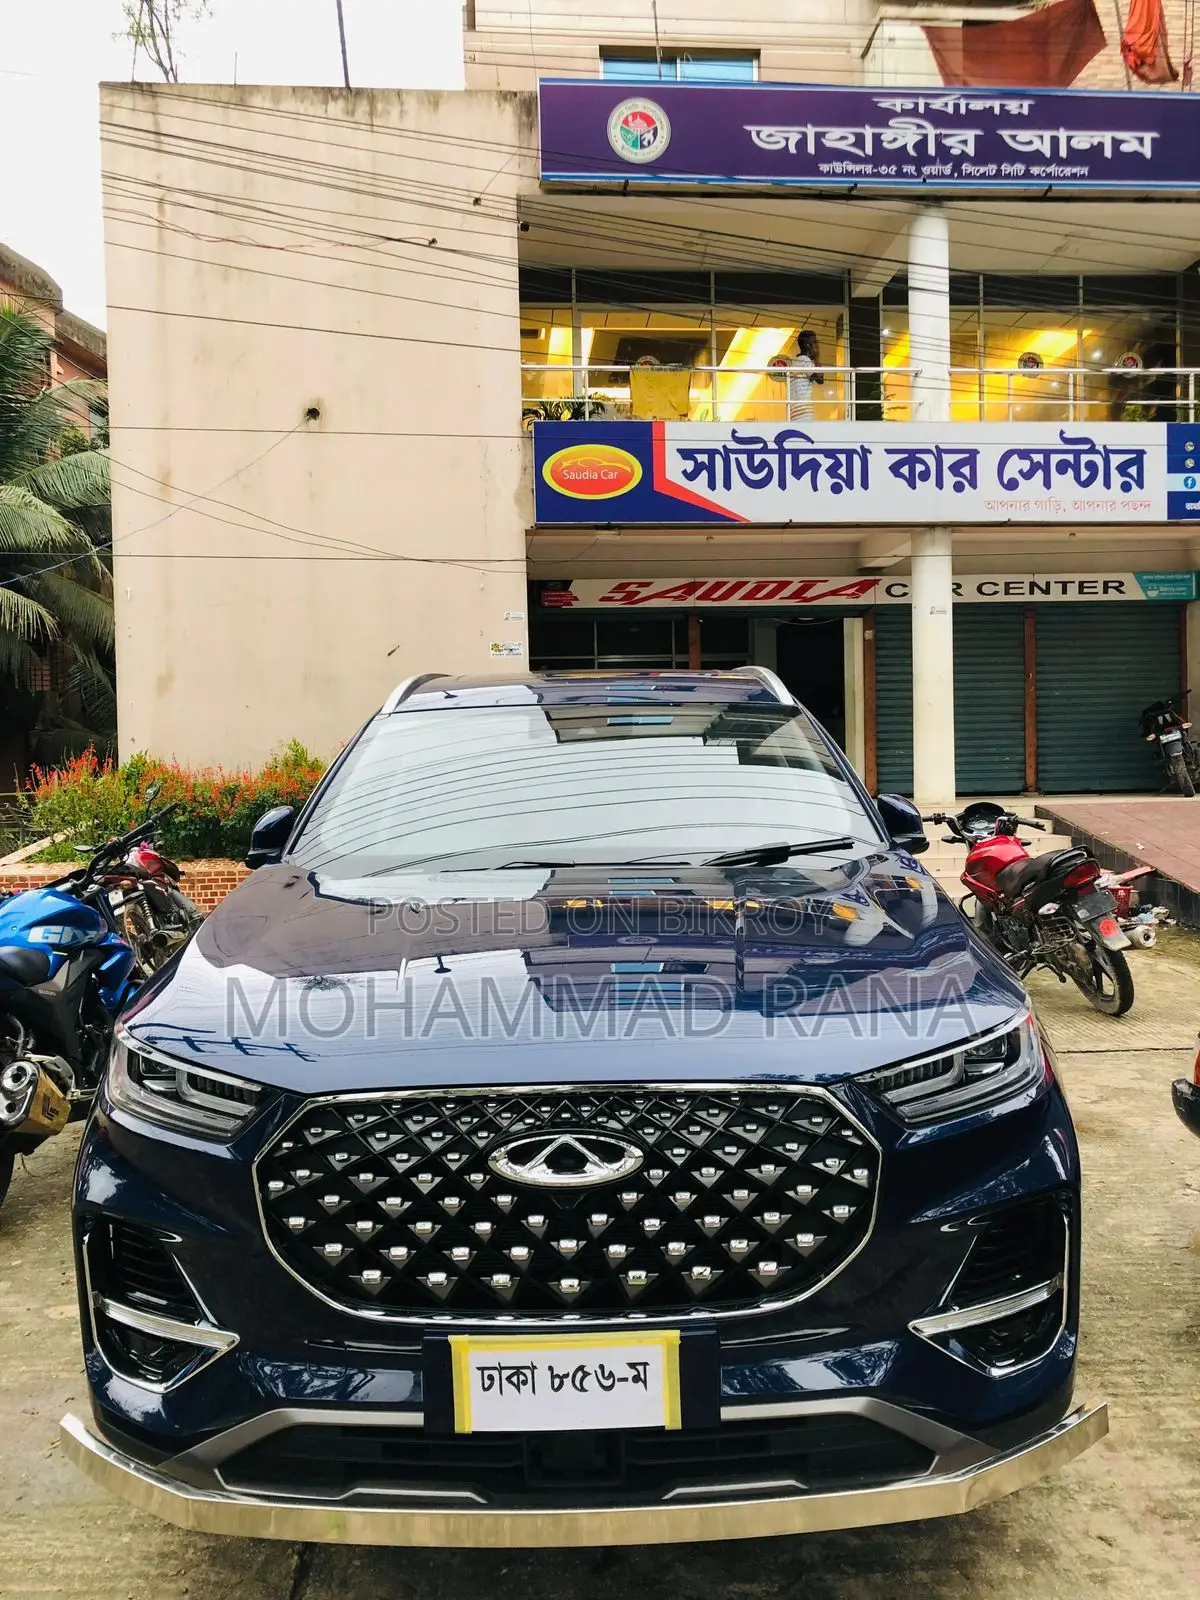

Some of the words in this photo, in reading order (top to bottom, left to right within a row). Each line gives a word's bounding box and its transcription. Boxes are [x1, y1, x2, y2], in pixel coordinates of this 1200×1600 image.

[872, 94, 1035, 115] কার্যালয়
[743, 117, 984, 157] জাহাঙ্গীর
[996, 126, 1160, 159] আলম
[902, 163, 917, 176] নং
[962, 163, 997, 176] সিলেট
[1000, 163, 1026, 176] সিটি
[676, 428, 872, 495] সাউদিয়া
[884, 444, 981, 493] কার
[997, 429, 1147, 494] সেন্টার
[563, 469, 598, 480] Saudia
[600, 469, 618, 480] Car
[984, 499, 1030, 512] আপনার
[1072, 499, 1116, 512] আপনার
[598, 579, 882, 605] SAUDIA
[885, 581, 964, 598] CR
[976, 580, 1126, 596] CENTER
[476, 1361, 538, 1396] ঢাকা
[547, 1361, 650, 1393] ৮৫৬-ম
